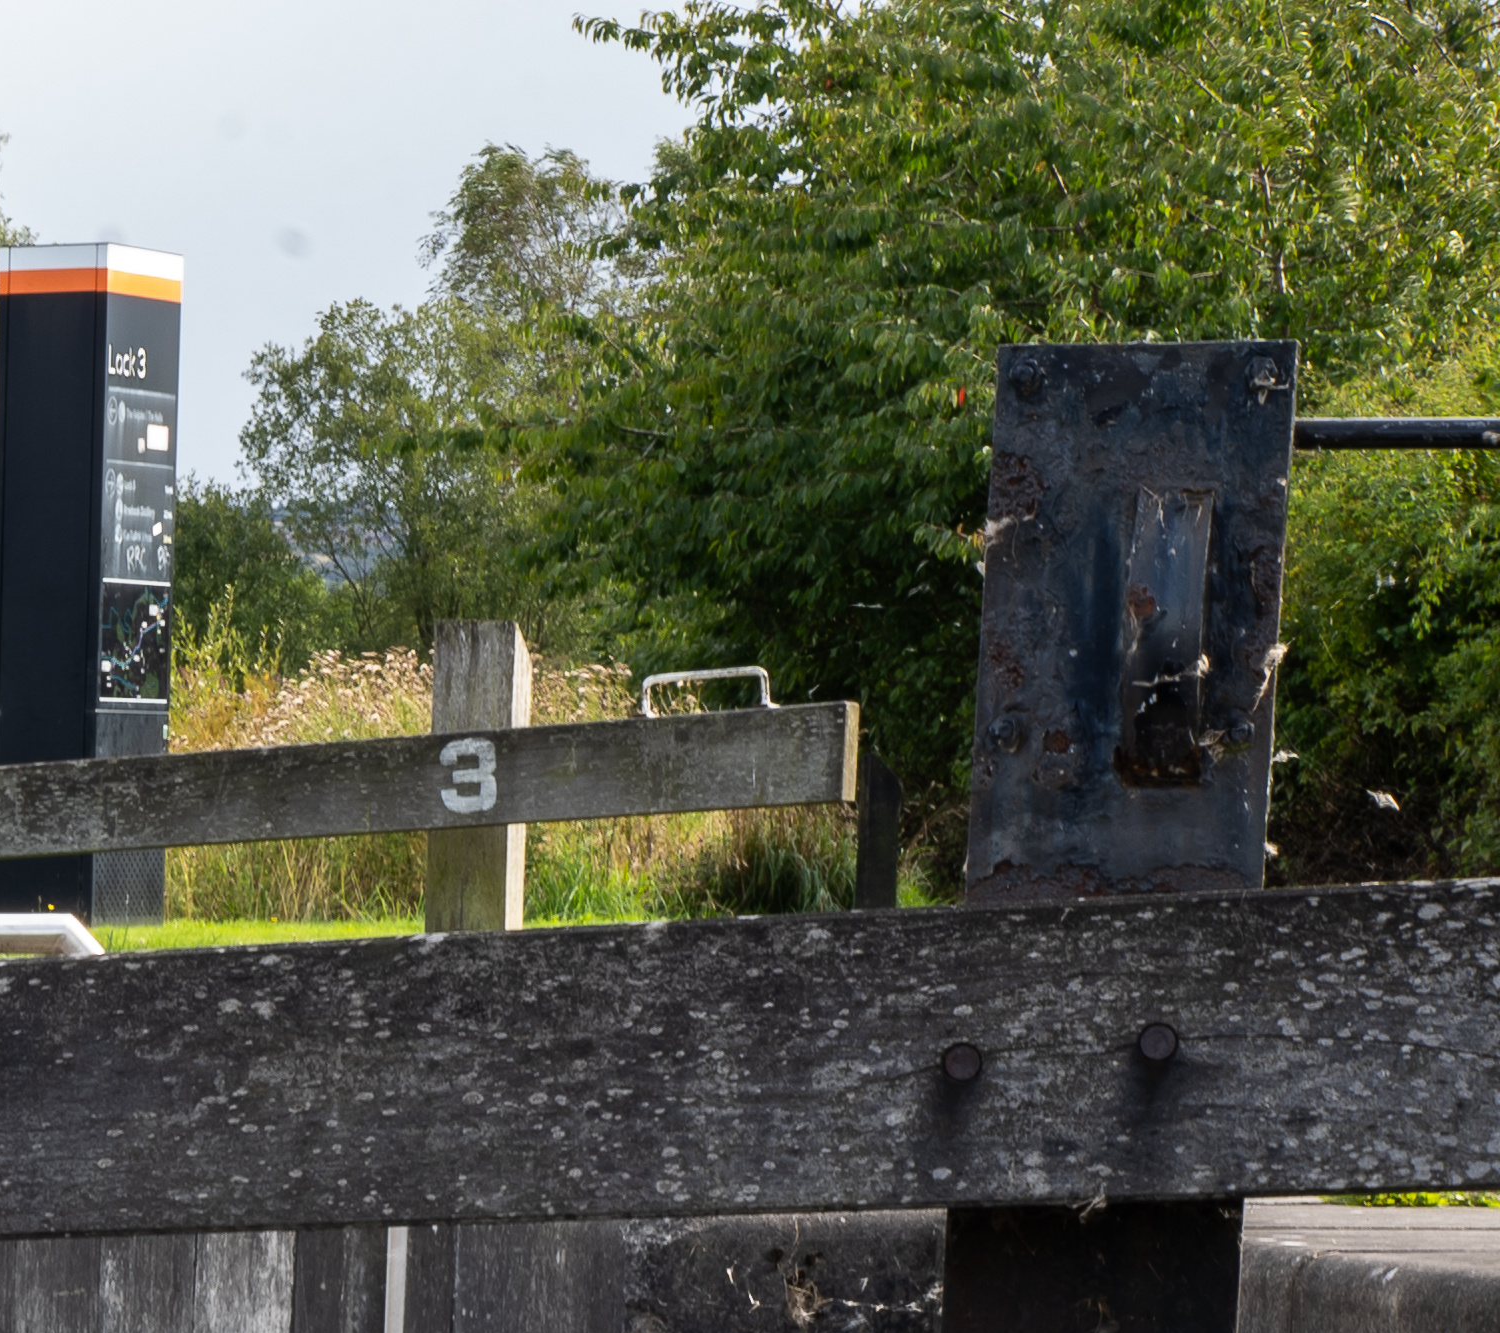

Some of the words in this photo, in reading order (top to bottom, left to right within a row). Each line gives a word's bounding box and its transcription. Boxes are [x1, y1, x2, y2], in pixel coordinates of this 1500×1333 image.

[108, 343, 136, 377] Lock
[137, 347, 147, 379] 3
[440, 737, 497, 814] 3
